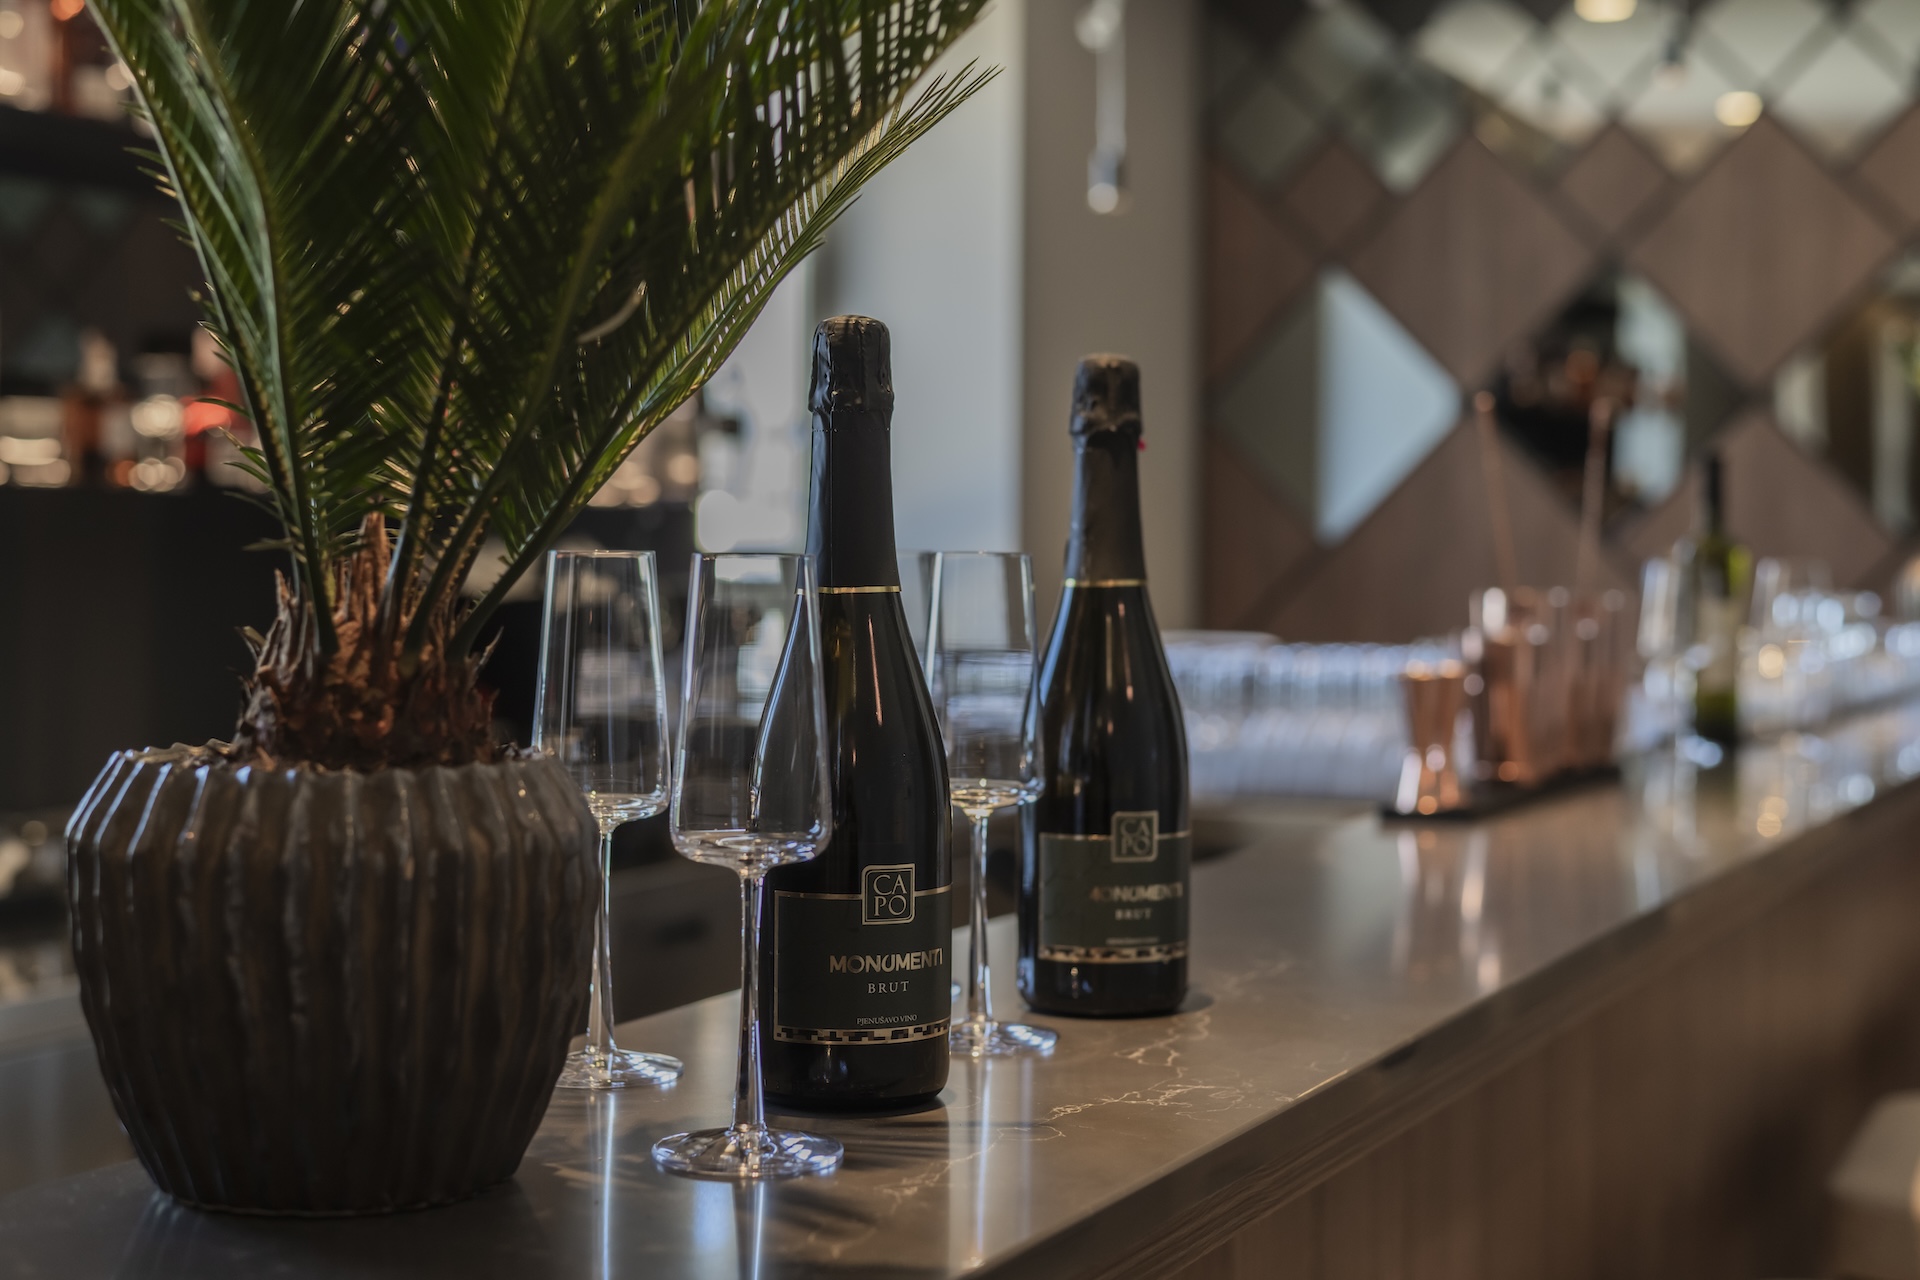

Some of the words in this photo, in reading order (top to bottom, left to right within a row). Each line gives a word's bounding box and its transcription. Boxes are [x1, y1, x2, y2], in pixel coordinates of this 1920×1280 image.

[873, 874, 908, 896] CA
[873, 894, 907, 917] PO
[829, 947, 944, 974] MONUMENTI
[868, 980, 910, 994] BRUT
[856, 1015, 900, 1027] PJENUŠAVO
[900, 1013, 918, 1023] VINO
